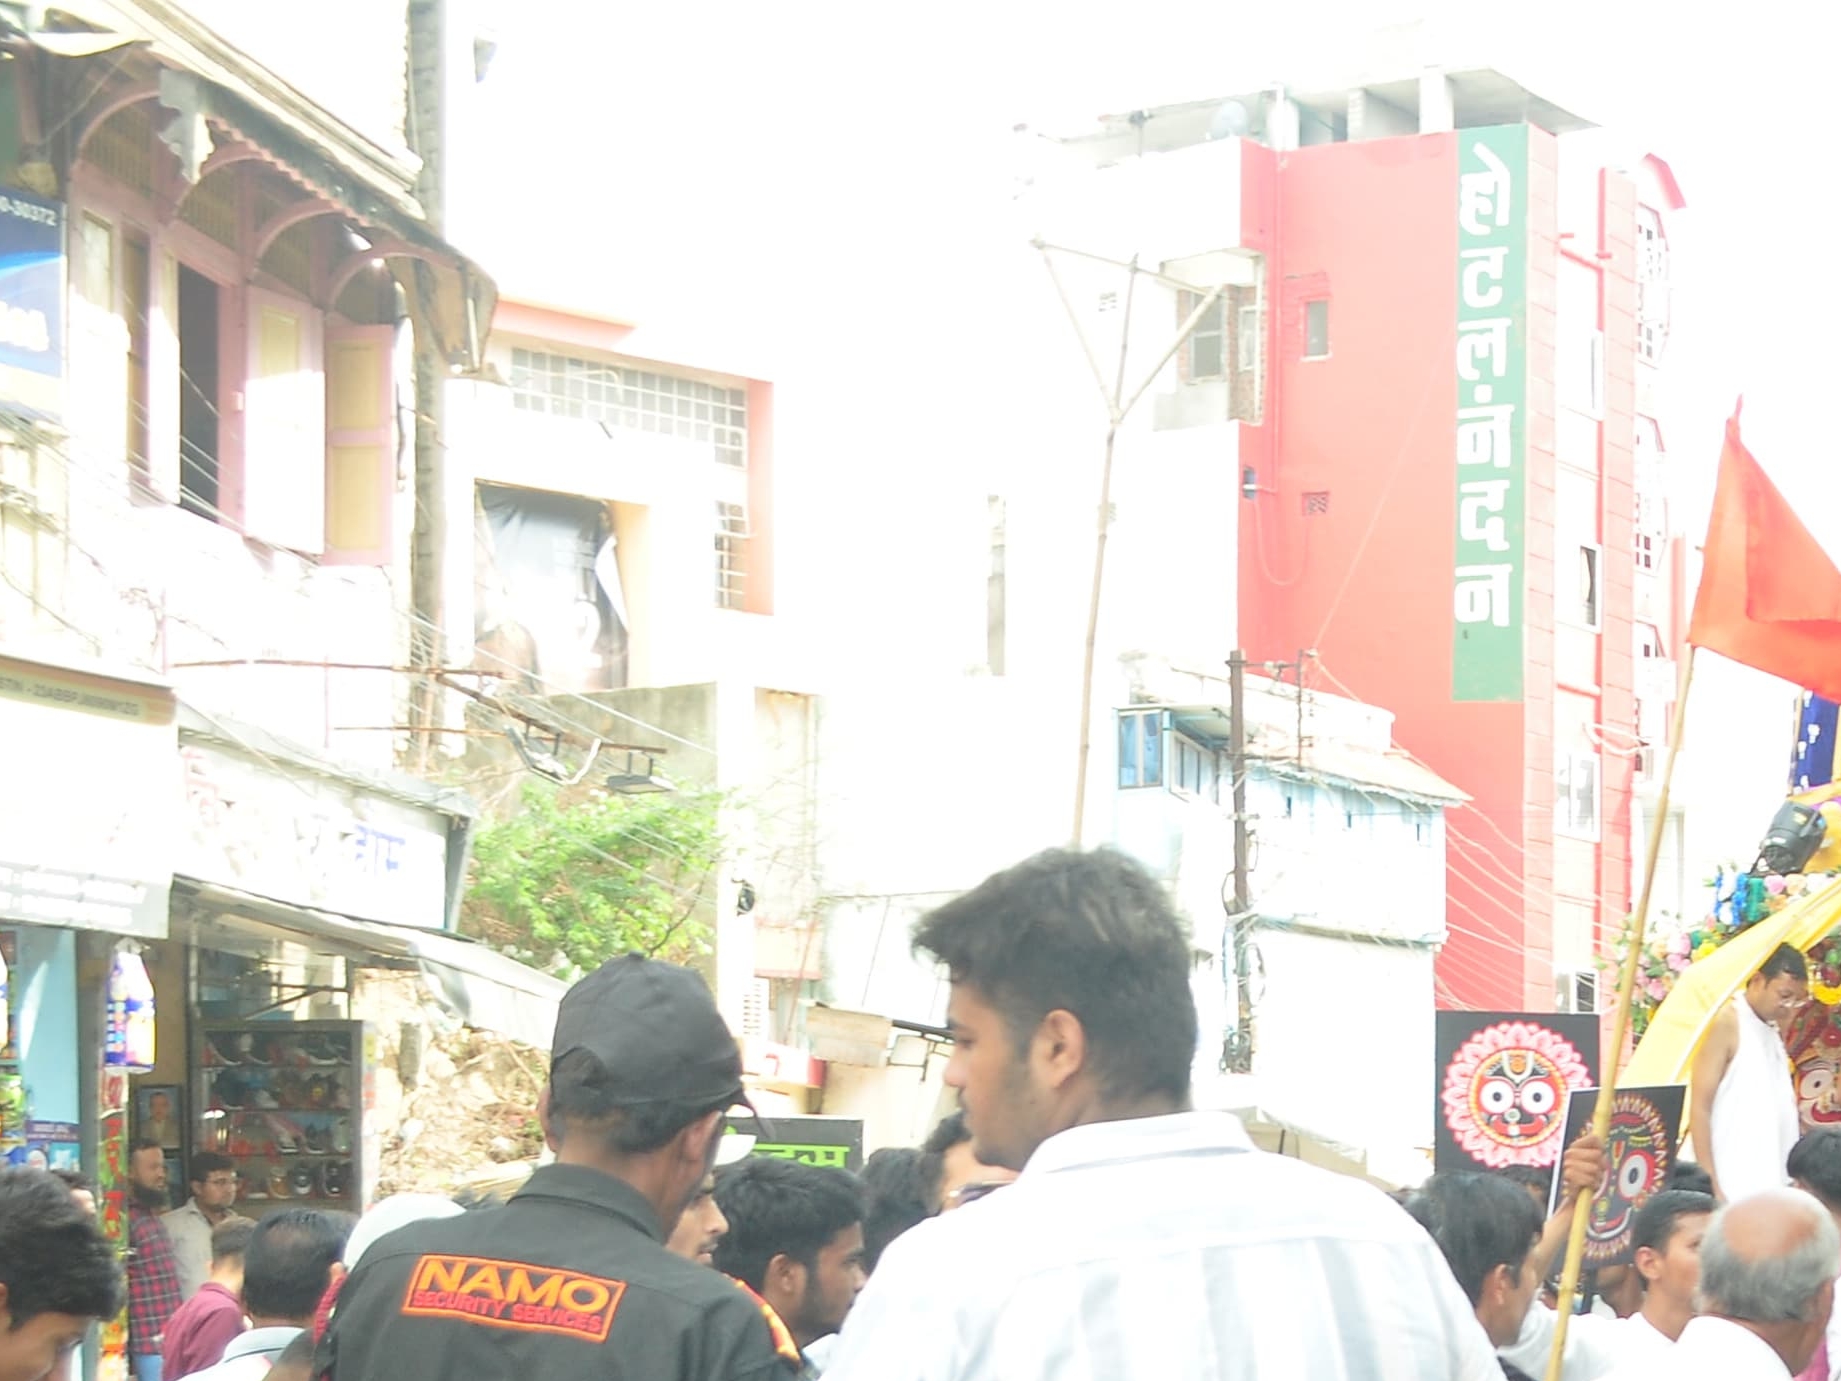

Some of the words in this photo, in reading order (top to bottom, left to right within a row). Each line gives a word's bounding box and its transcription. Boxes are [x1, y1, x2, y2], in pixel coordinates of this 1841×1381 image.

[416, 1259, 611, 1314] NAMO
[412, 1290, 508, 1319] SECURITY
[512, 1303, 603, 1332] SERVICES
